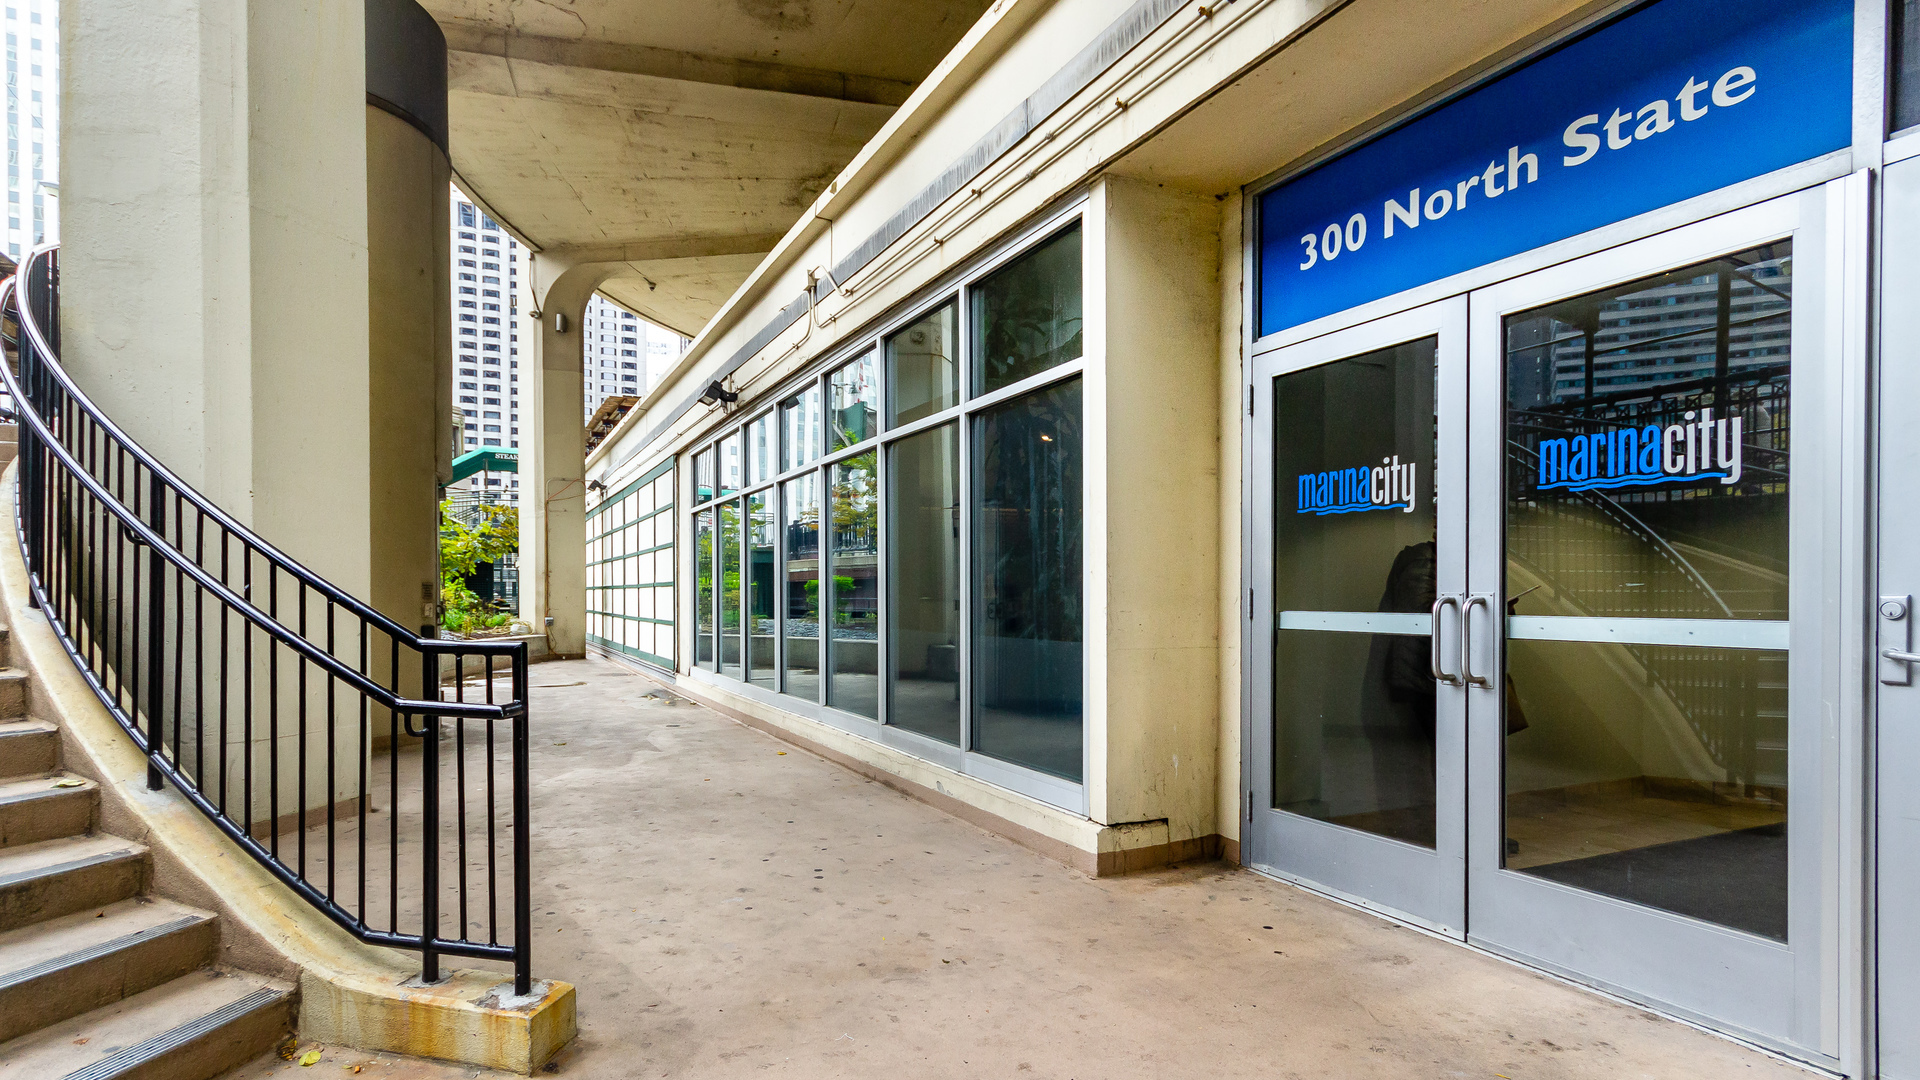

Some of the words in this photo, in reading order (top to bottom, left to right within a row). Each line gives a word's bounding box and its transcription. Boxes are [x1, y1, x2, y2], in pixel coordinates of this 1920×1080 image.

[1300, 213, 1367, 271] 300
[1384, 145, 1538, 239] North
[1562, 65, 1757, 167] State
